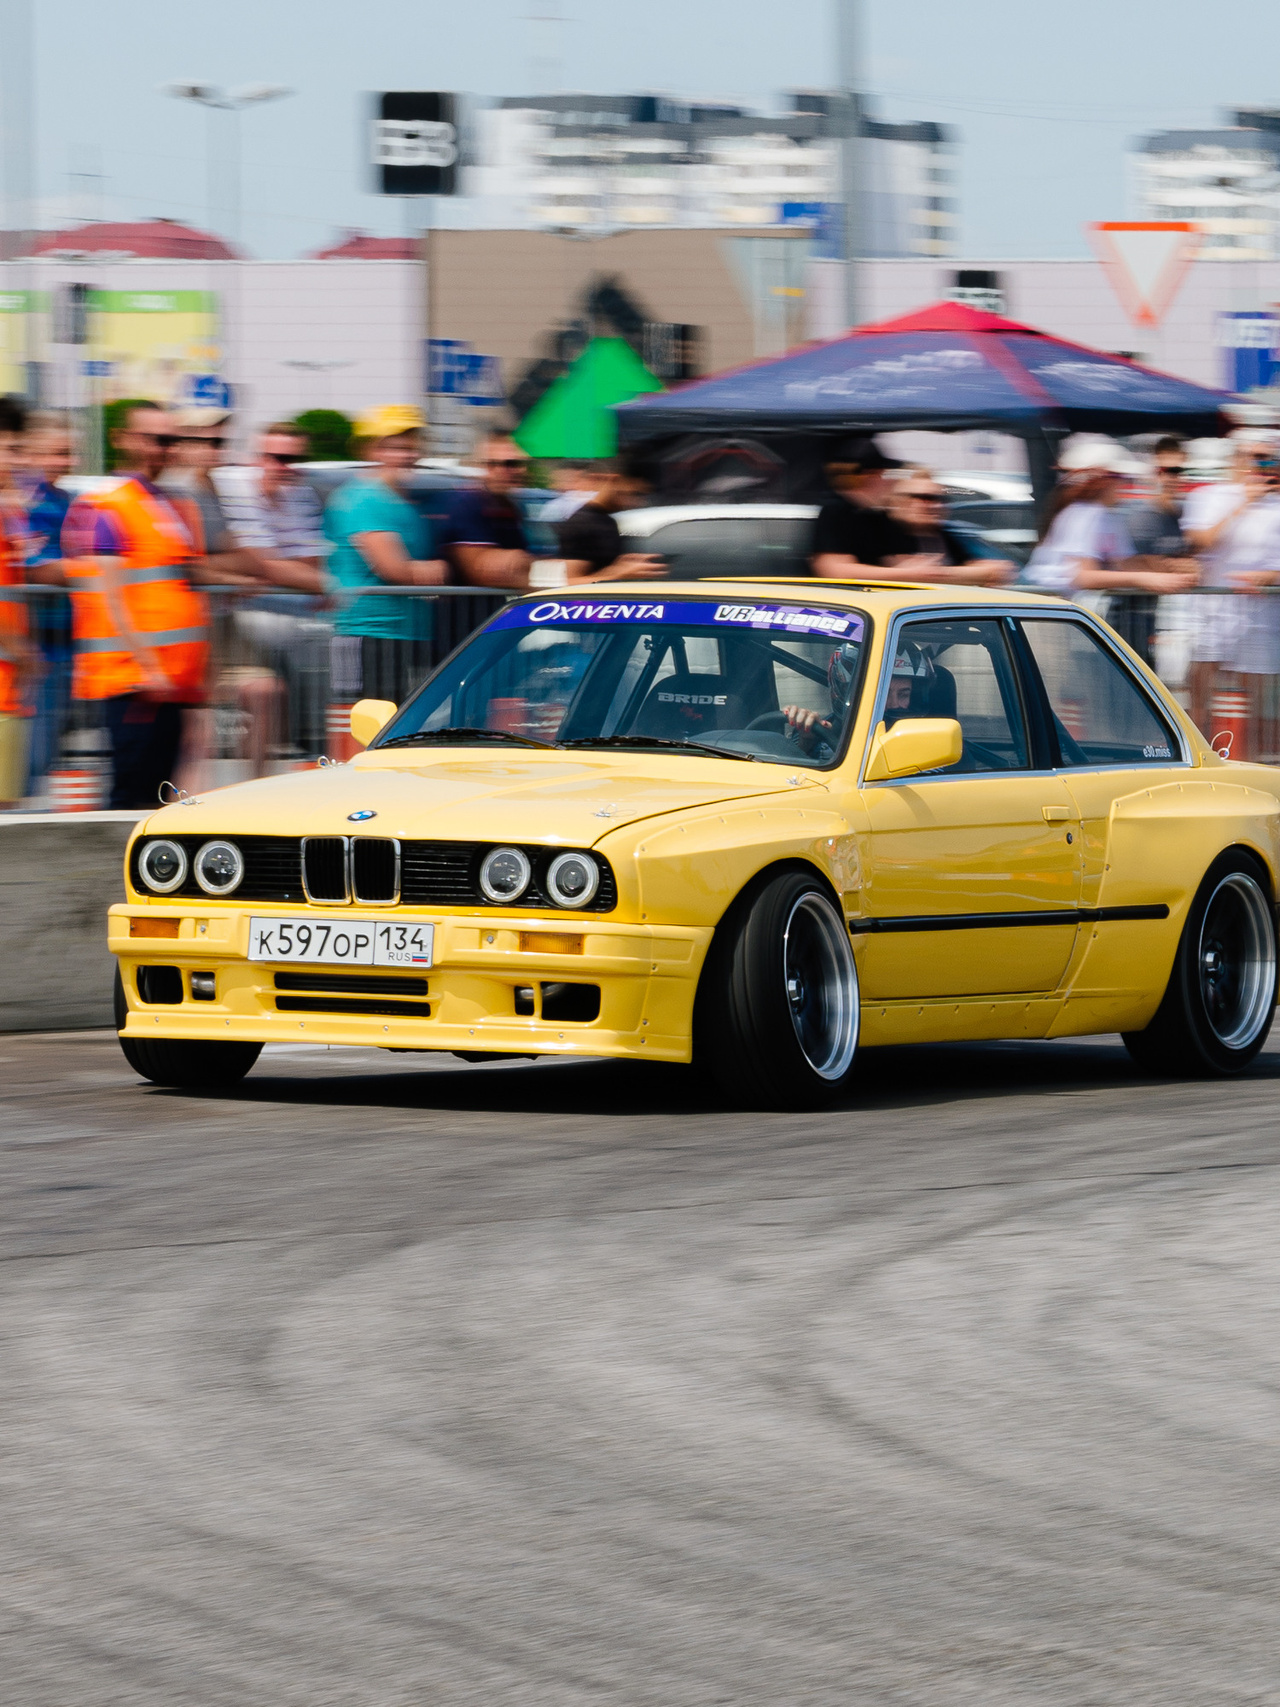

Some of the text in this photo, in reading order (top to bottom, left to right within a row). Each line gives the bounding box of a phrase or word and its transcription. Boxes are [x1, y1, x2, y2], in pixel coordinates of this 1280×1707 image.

[658, 692, 728, 706] BRIDE
[379, 926, 424, 952] 134
[388, 951, 411, 962] RUS
